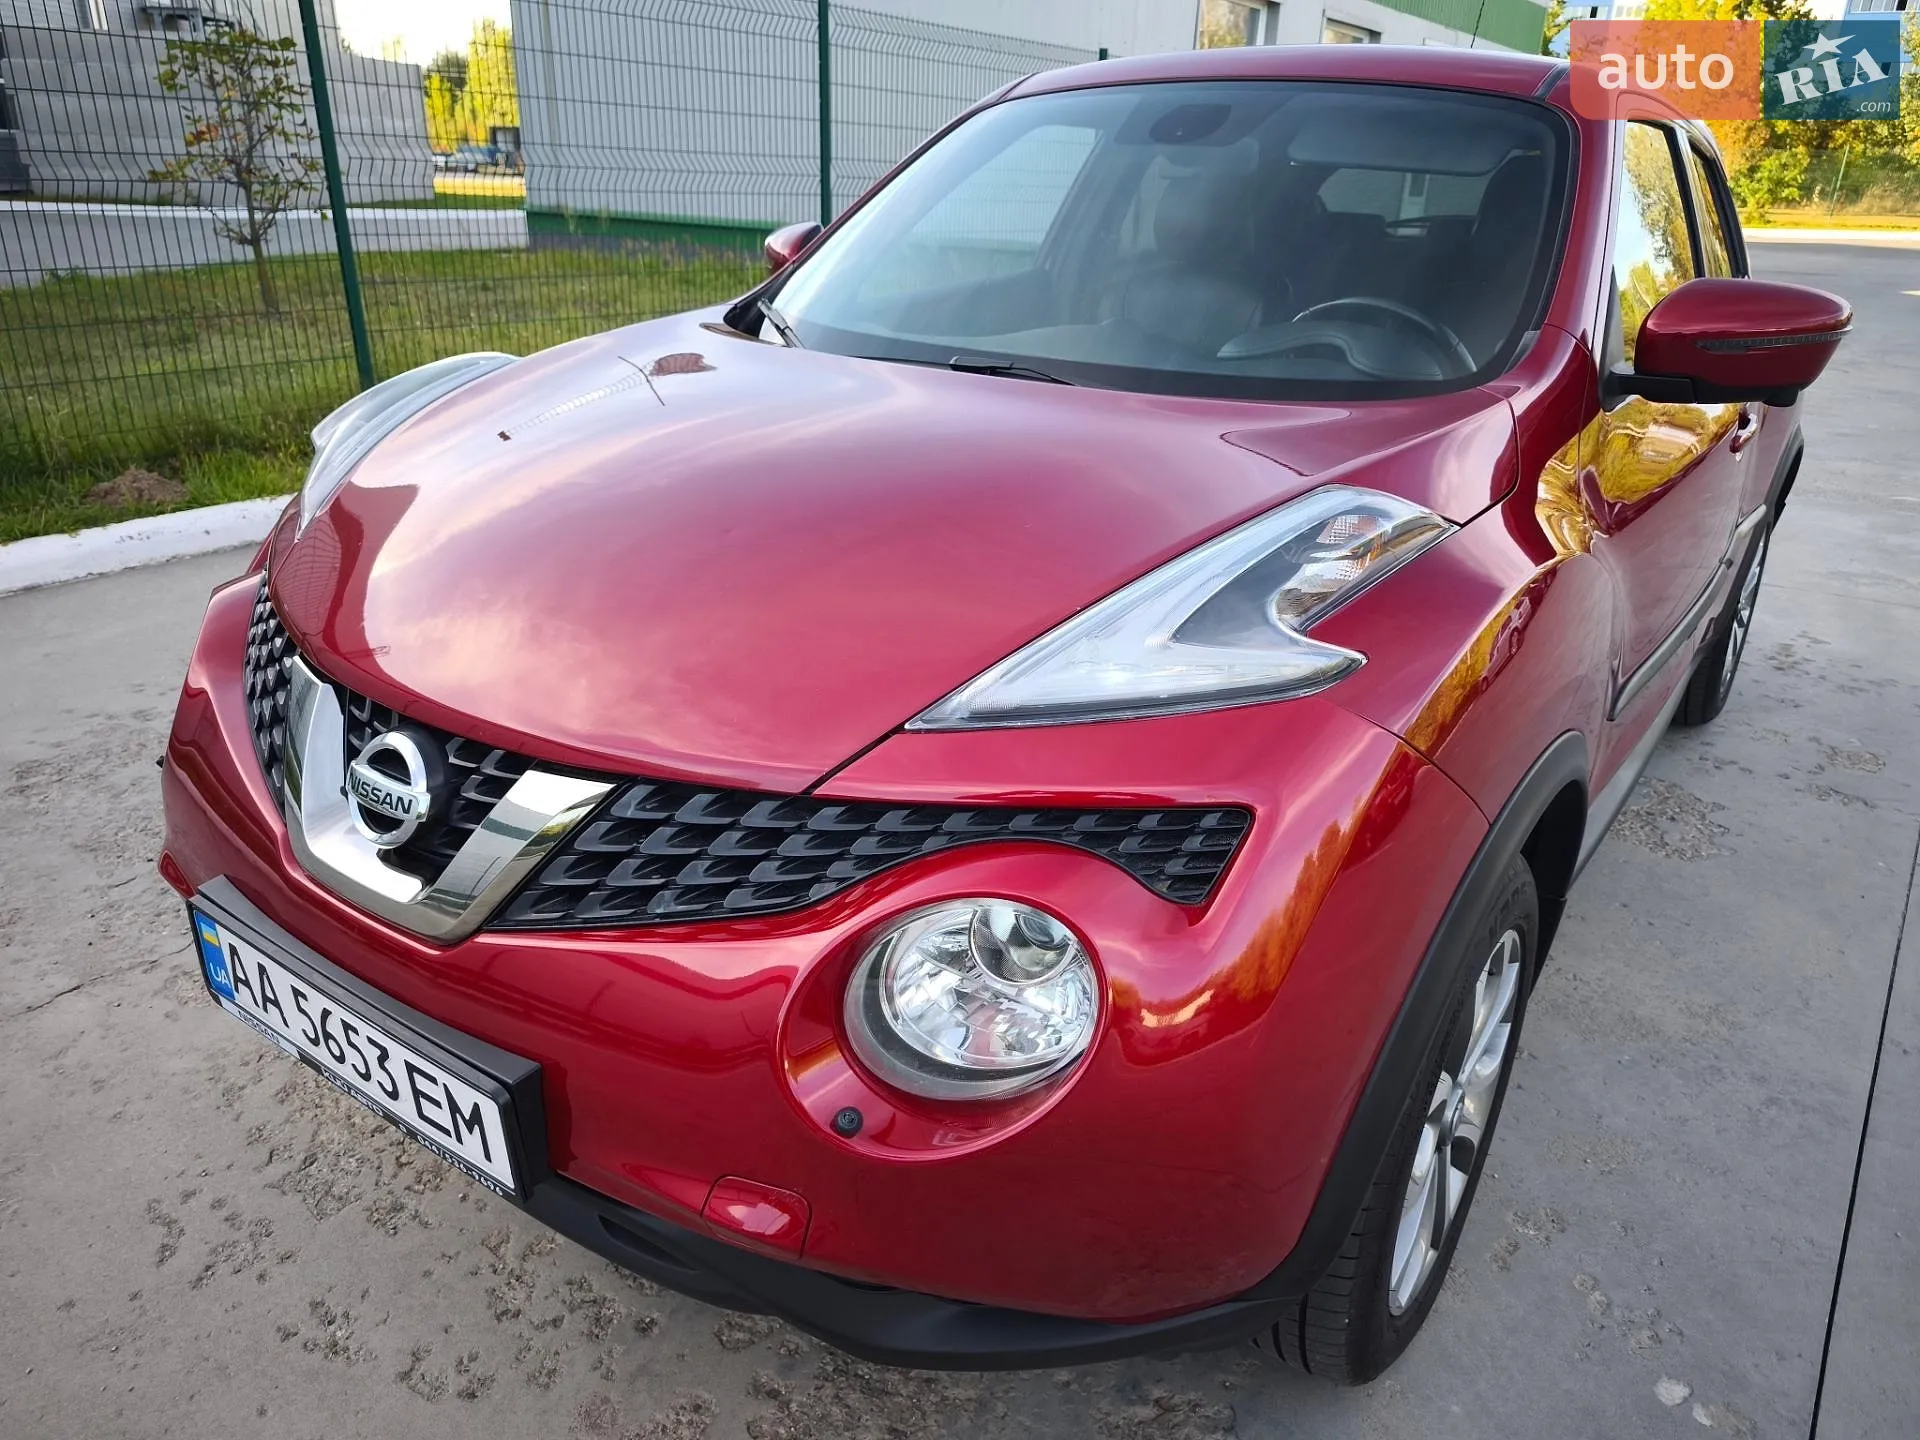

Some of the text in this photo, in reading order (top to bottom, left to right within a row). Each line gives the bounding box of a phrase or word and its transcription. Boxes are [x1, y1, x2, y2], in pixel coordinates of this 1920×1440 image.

[347, 772, 413, 815] NISSAN
[209, 962, 232, 989] UA
[228, 943, 492, 1163] AA 5653 EM
